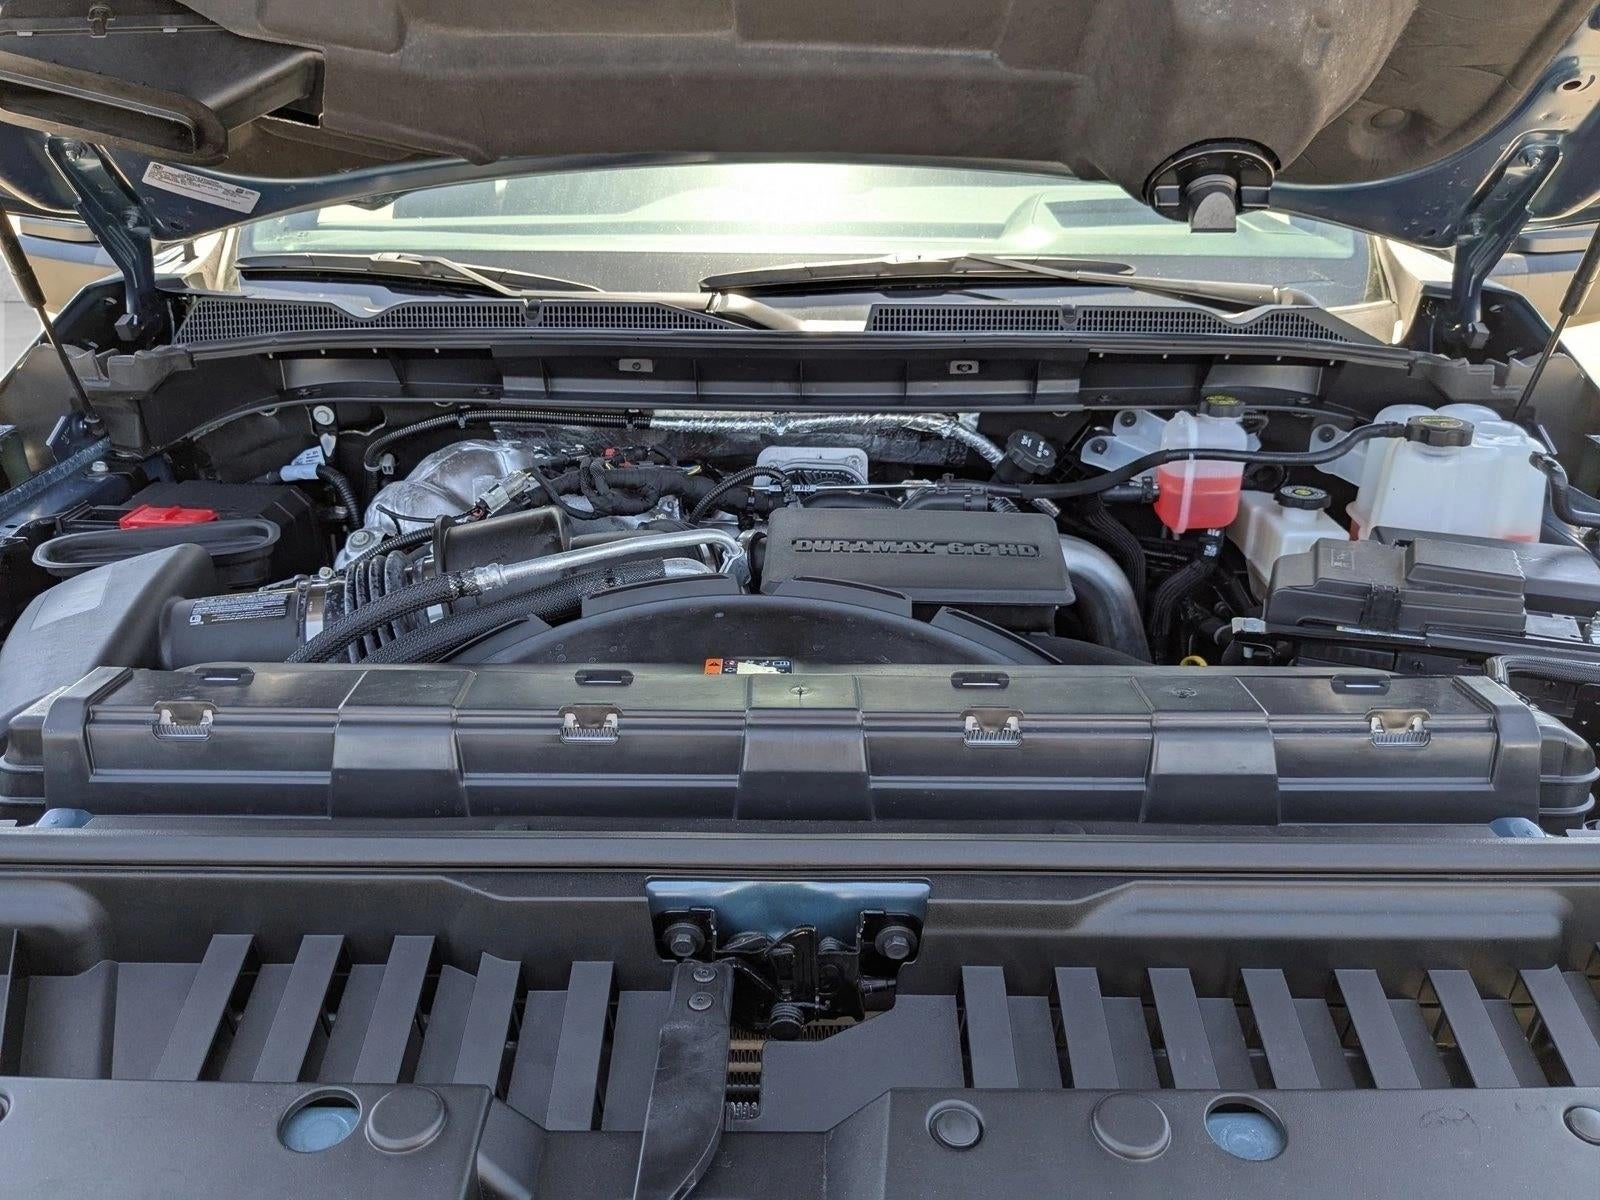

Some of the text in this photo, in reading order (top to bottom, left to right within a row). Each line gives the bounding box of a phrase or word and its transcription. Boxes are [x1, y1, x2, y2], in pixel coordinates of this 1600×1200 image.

[793, 539, 1039, 557] DURAMAX 6.6 HD
